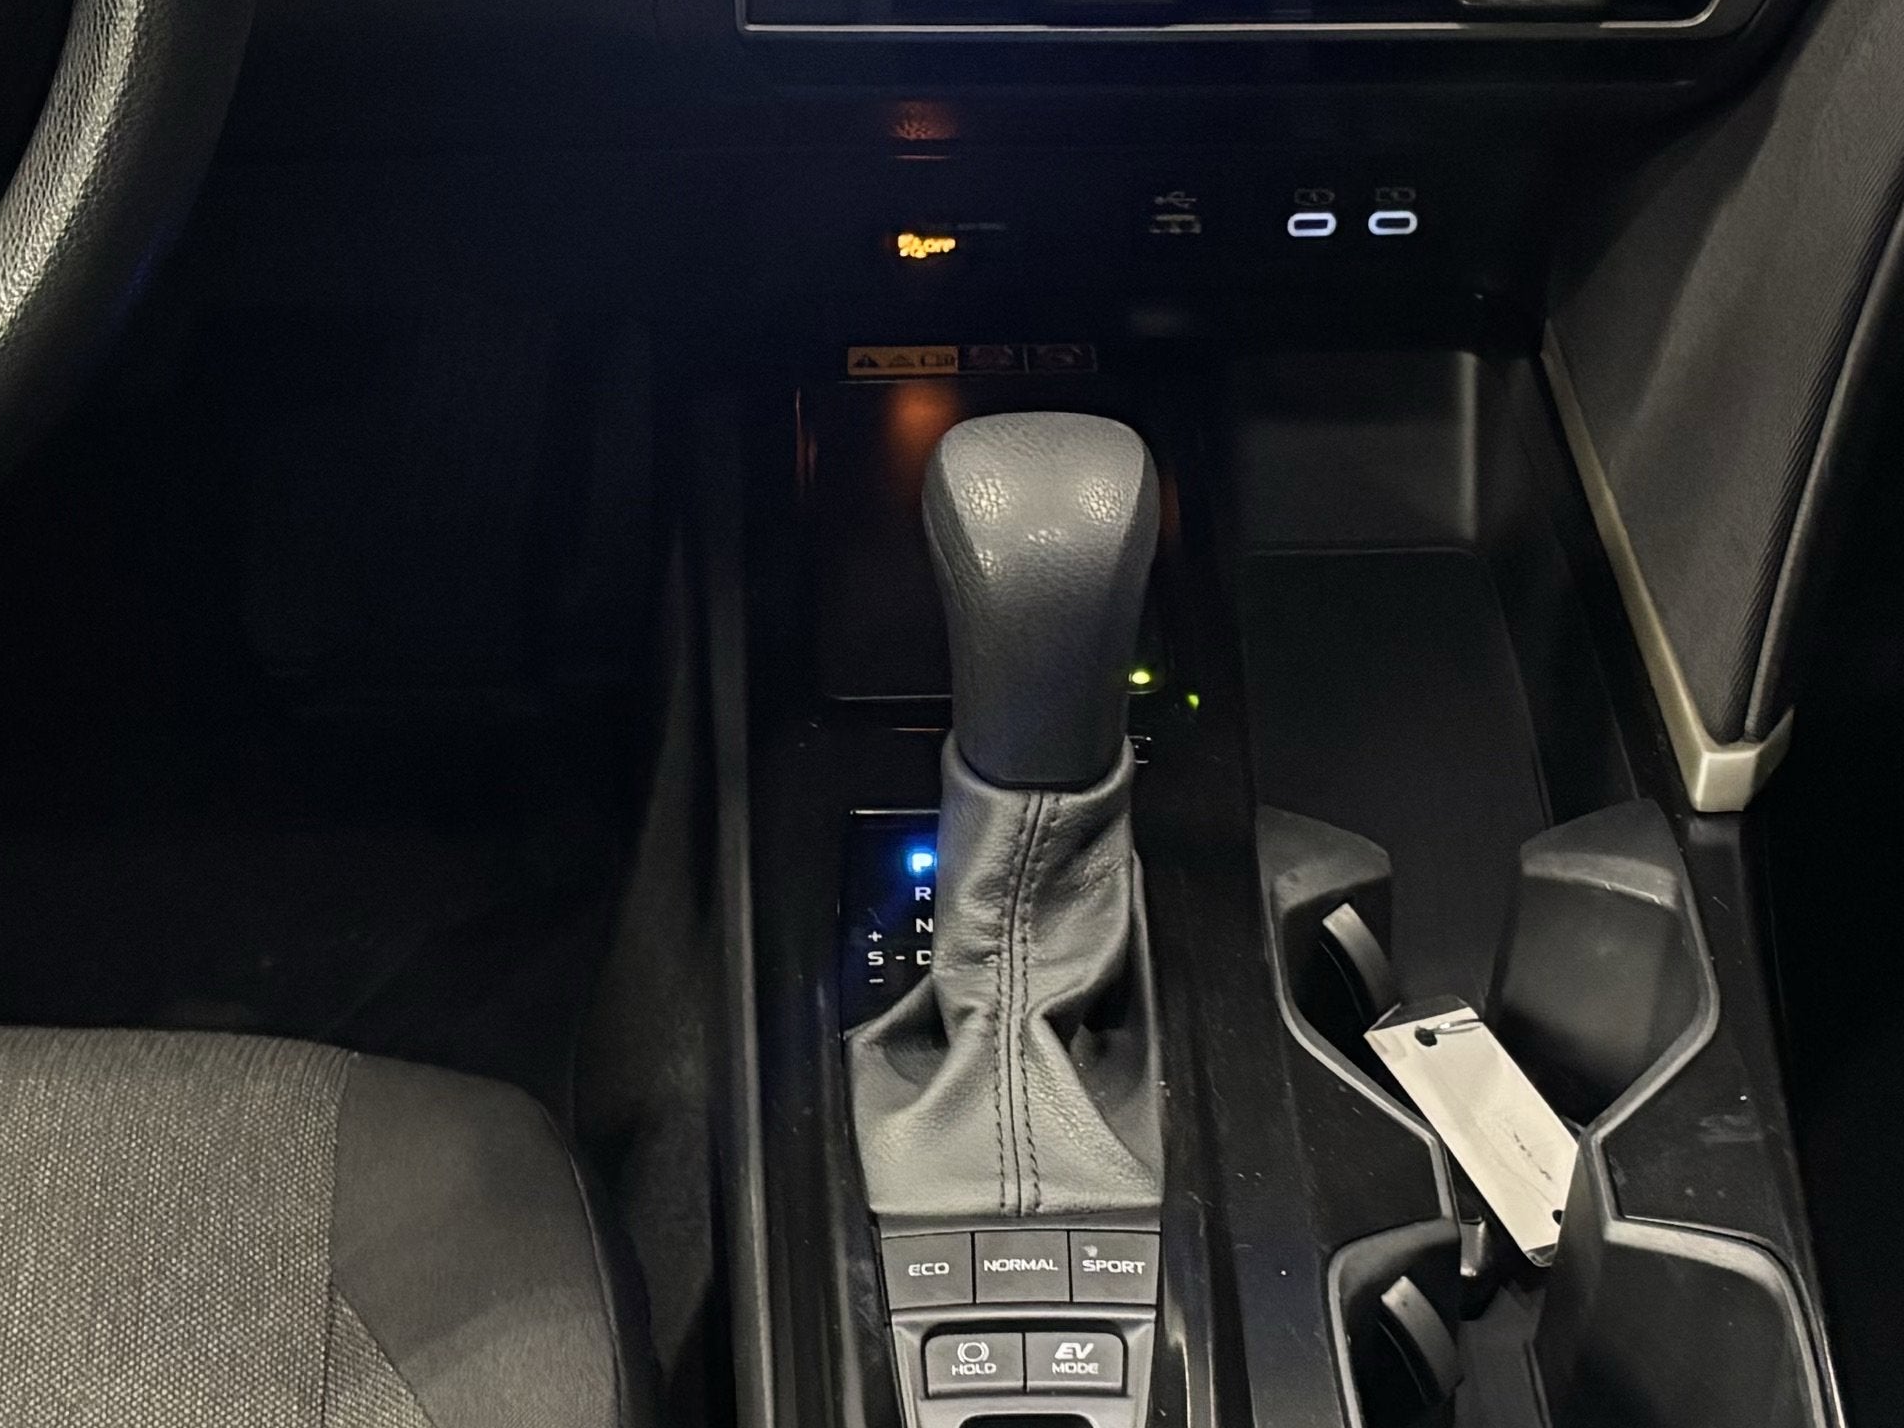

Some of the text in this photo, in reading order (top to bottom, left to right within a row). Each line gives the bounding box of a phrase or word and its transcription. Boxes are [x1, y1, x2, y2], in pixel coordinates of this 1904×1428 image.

[911, 852, 934, 873] P
[914, 886, 932, 901] R
[915, 917, 934, 933] N
[867, 950, 884, 966] S
[908, 1261, 950, 1277] ECO
[983, 1259, 1059, 1273] NORMAL
[1081, 1259, 1146, 1275] SPORT
[1054, 1341, 1095, 1360] EV
[951, 1360, 997, 1376] HOLD
[1051, 1361, 1100, 1375] MODE
